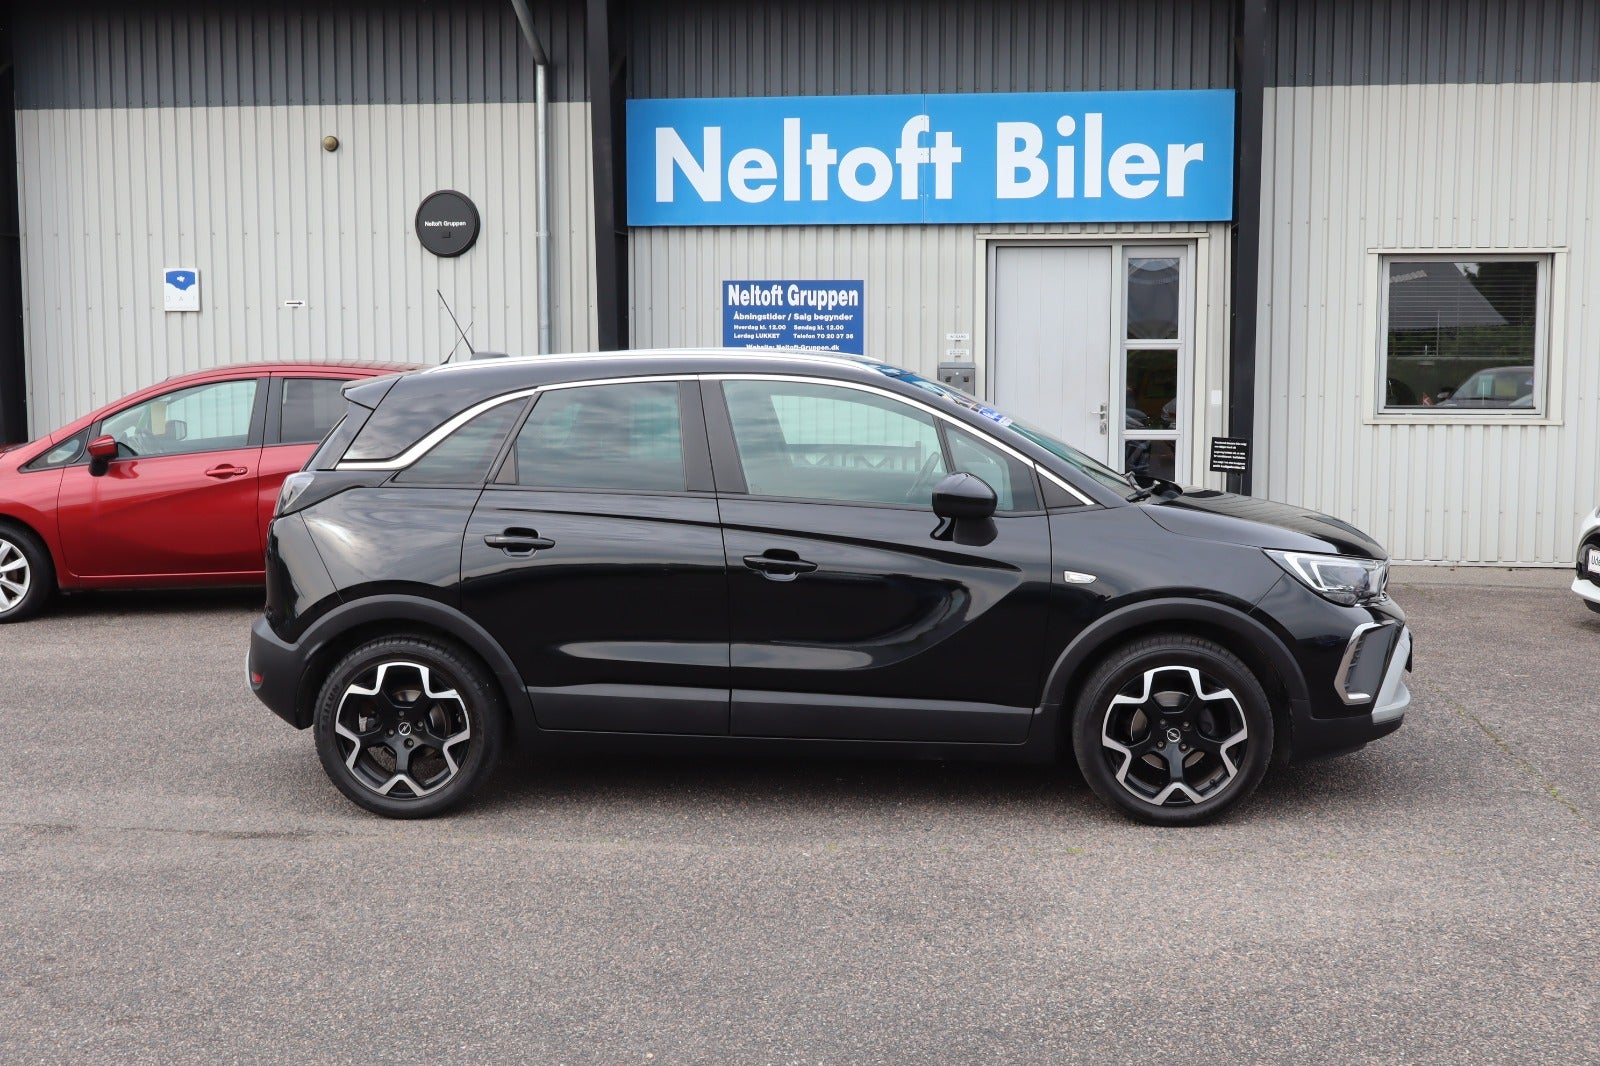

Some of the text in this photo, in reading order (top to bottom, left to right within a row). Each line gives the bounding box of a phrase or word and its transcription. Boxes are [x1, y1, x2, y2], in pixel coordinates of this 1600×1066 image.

[655, 112, 1204, 203] Neltoft Biler
[728, 284, 858, 310] Neltoft Gruppen
[733, 310, 787, 321] Åbningstider
[793, 312, 812, 321] Salg
[813, 312, 854, 321] begynder
